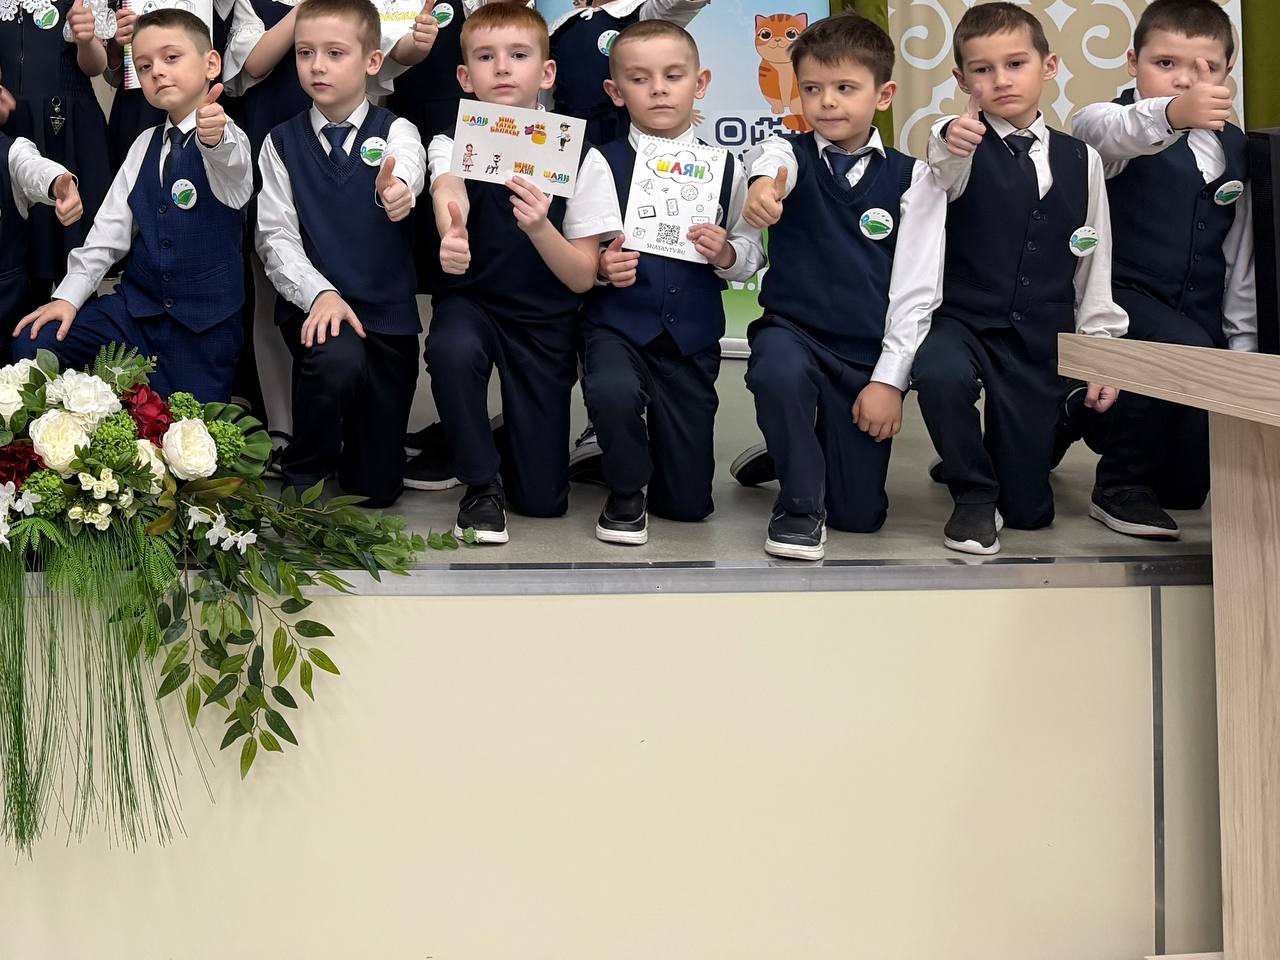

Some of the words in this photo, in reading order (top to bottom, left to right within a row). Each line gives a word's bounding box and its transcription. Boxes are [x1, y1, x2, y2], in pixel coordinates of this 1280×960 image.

[463, 115, 489, 125] ШАЯН
[656, 159, 705, 180] ШАЯН
[543, 170, 570, 182] ШАЯН
